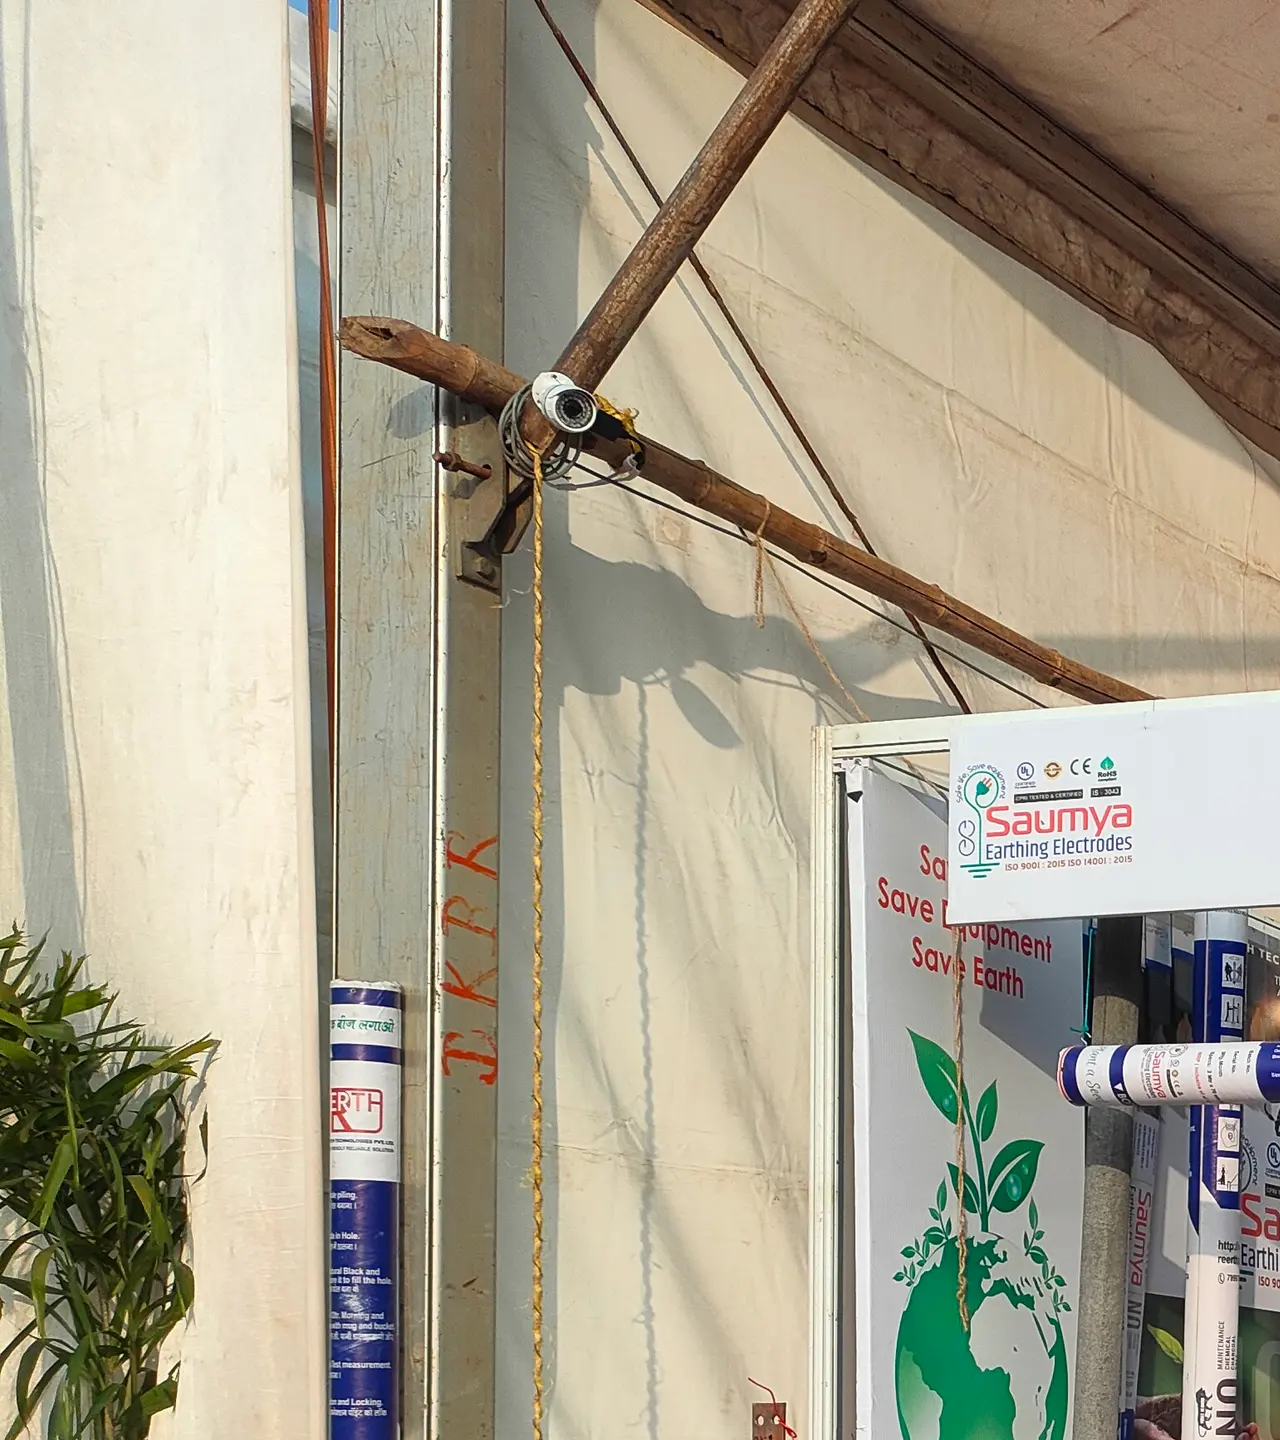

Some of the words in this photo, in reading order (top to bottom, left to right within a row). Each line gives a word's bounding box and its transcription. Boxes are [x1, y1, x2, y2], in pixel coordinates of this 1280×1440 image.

[986, 804, 1132, 837] Saumya
[986, 840, 1049, 860] Earthing
[1053, 834, 1132, 856] Electrodes
[973, 956, 1024, 999] Earth
[336, 1018, 357, 1033] बीज
[359, 1017, 395, 1033] लगाओ
